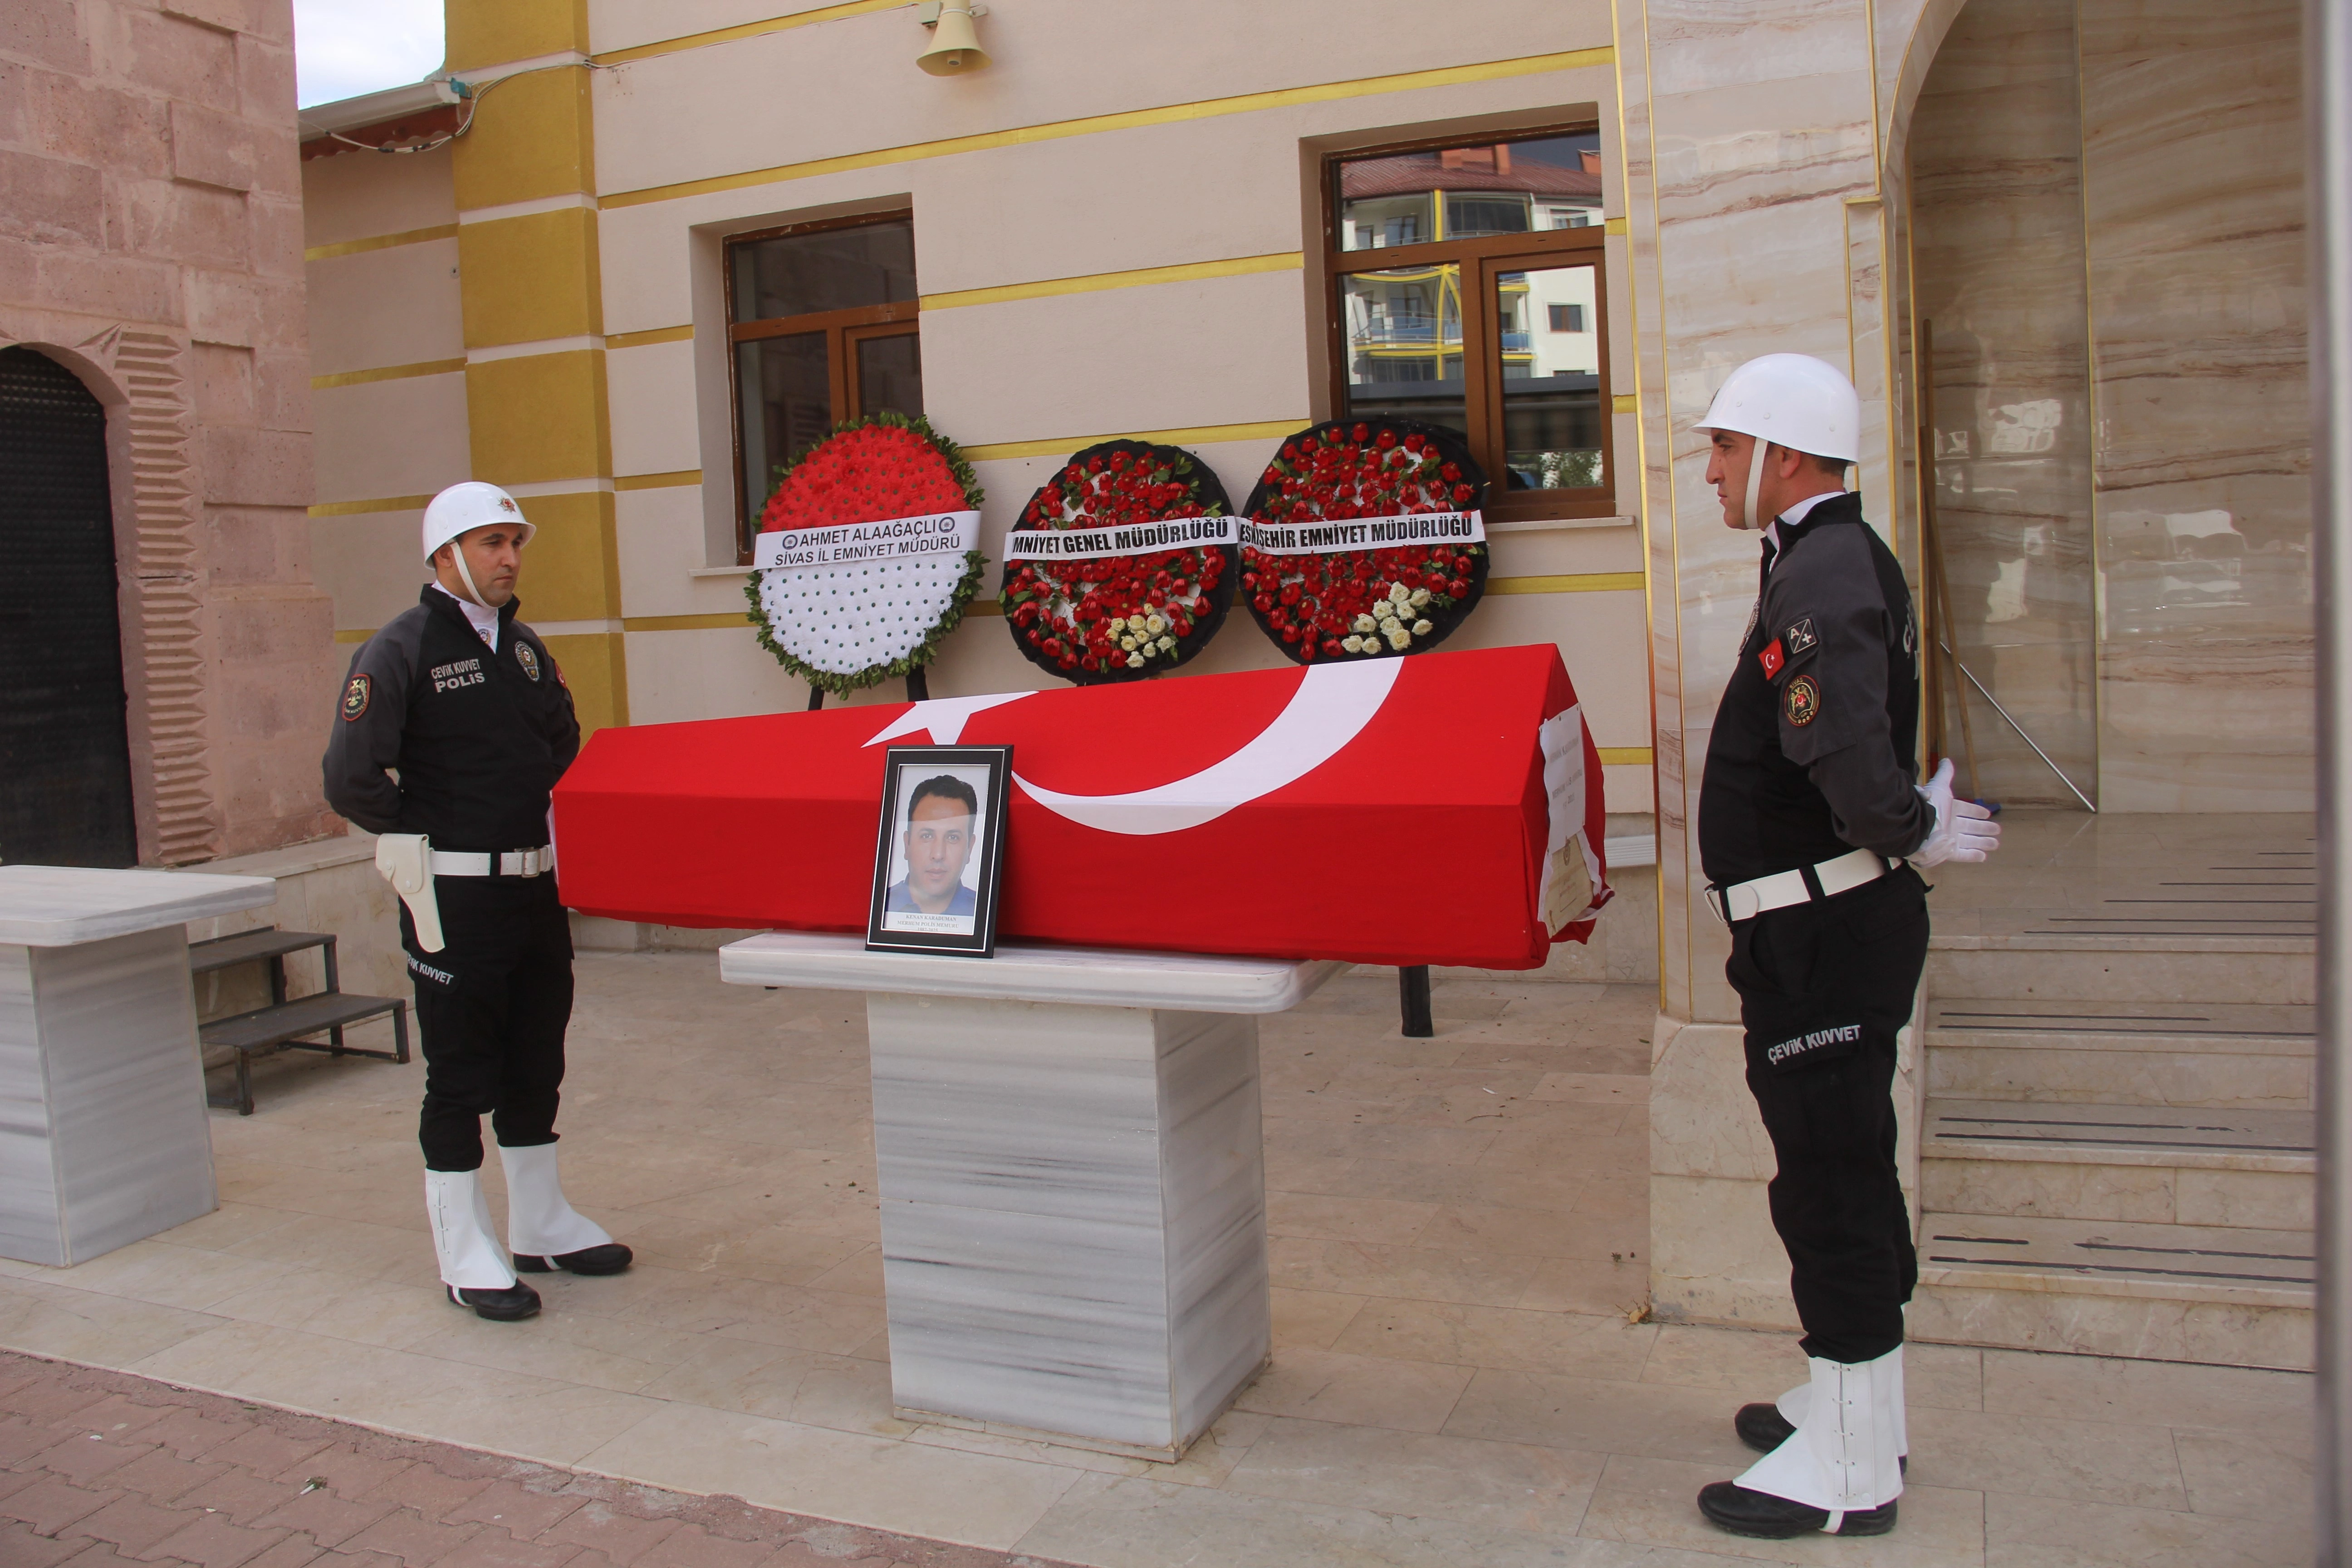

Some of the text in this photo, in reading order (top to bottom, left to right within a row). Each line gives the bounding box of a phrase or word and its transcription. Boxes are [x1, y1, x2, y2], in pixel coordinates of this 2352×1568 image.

[799, 519, 936, 547] AHMET ALAAĞAÇLI
[1013, 518, 1228, 554] MNİYET GENEL MÜDÜRLÜĞÜ
[1240, 524, 1296, 550] ESKİŞEHİR
[1300, 523, 1367, 547] EMNİYET
[775, 535, 960, 565] SİVAS İL EMNİYET MÜDÜRÜ
[453, 658, 480, 674] KUVVET
[419, 962, 454, 985] KUVVET
[1805, 1024, 1861, 1049] KUVVET
